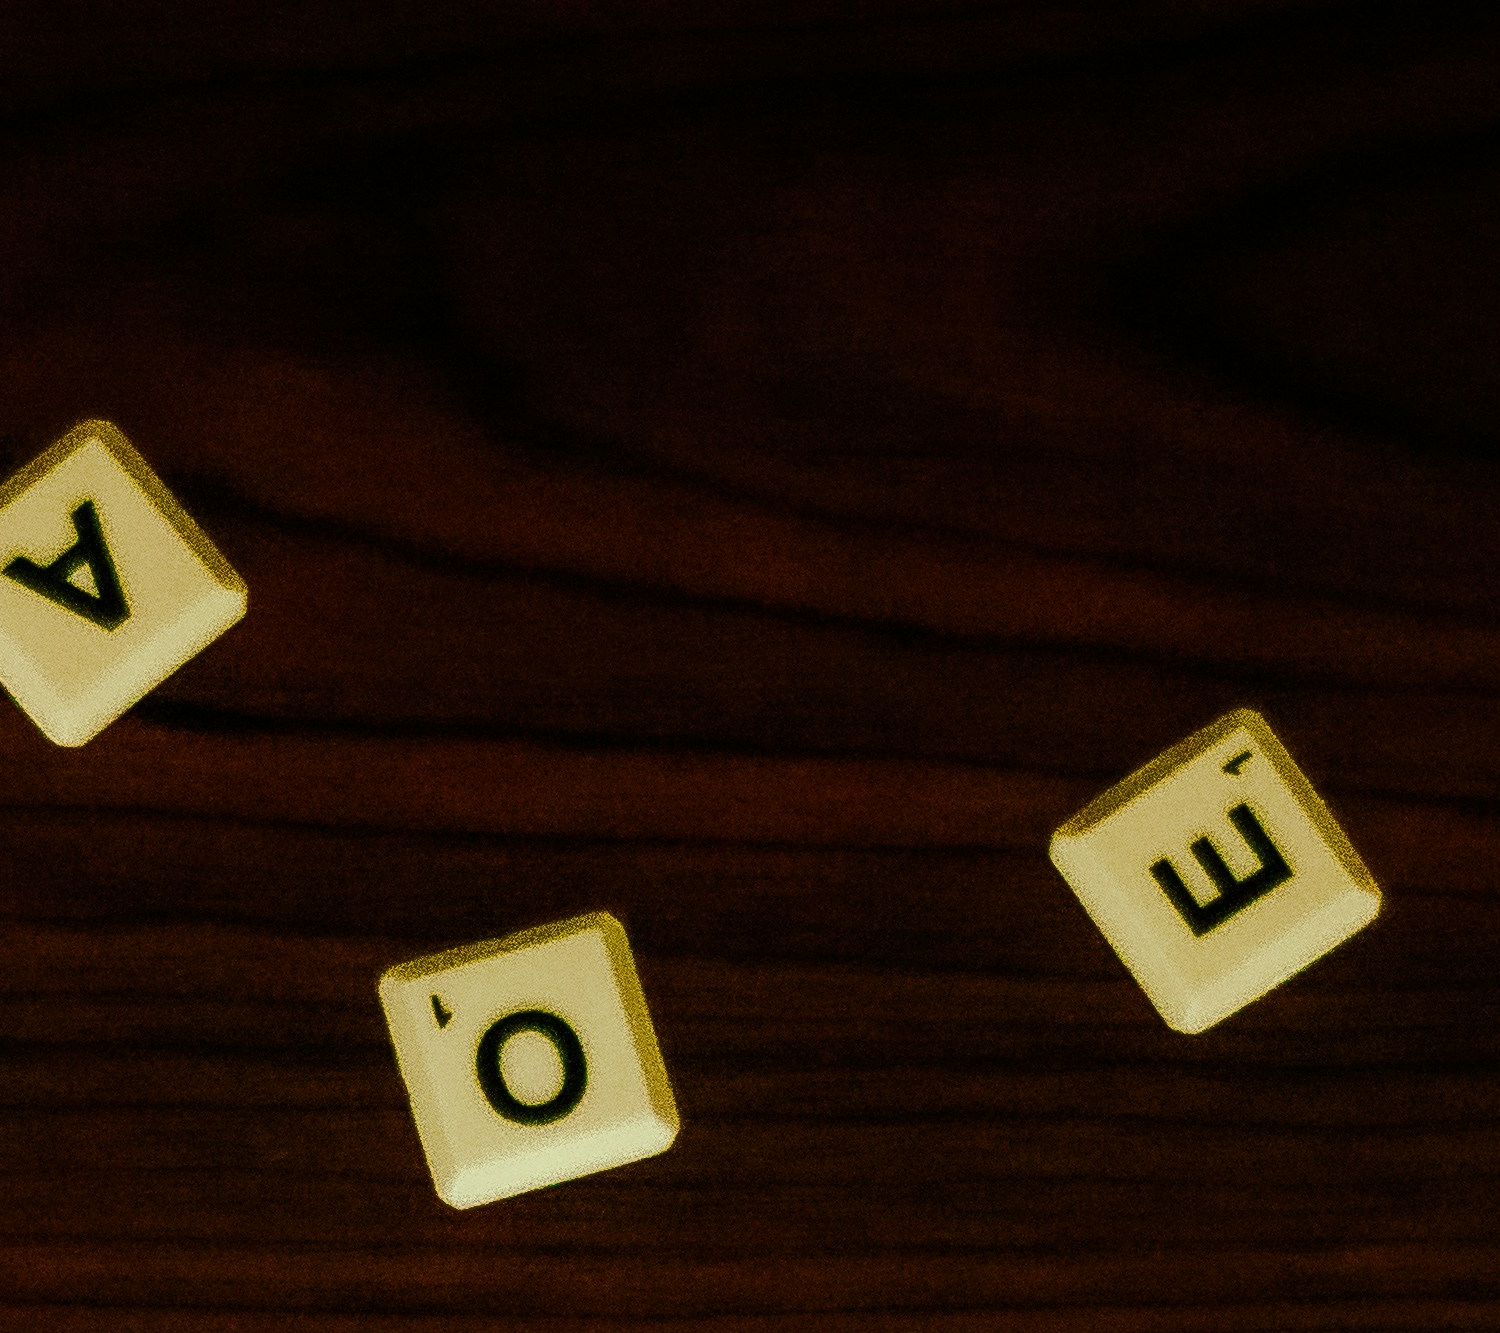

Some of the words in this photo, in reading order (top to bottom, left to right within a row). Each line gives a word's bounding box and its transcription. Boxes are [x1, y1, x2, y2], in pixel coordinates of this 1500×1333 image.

[1, 498, 131, 631] A
[1223, 751, 1252, 775] 1
[1149, 801, 1294, 938] E
[431, 995, 451, 1027] 1
[474, 1007, 590, 1127] O
